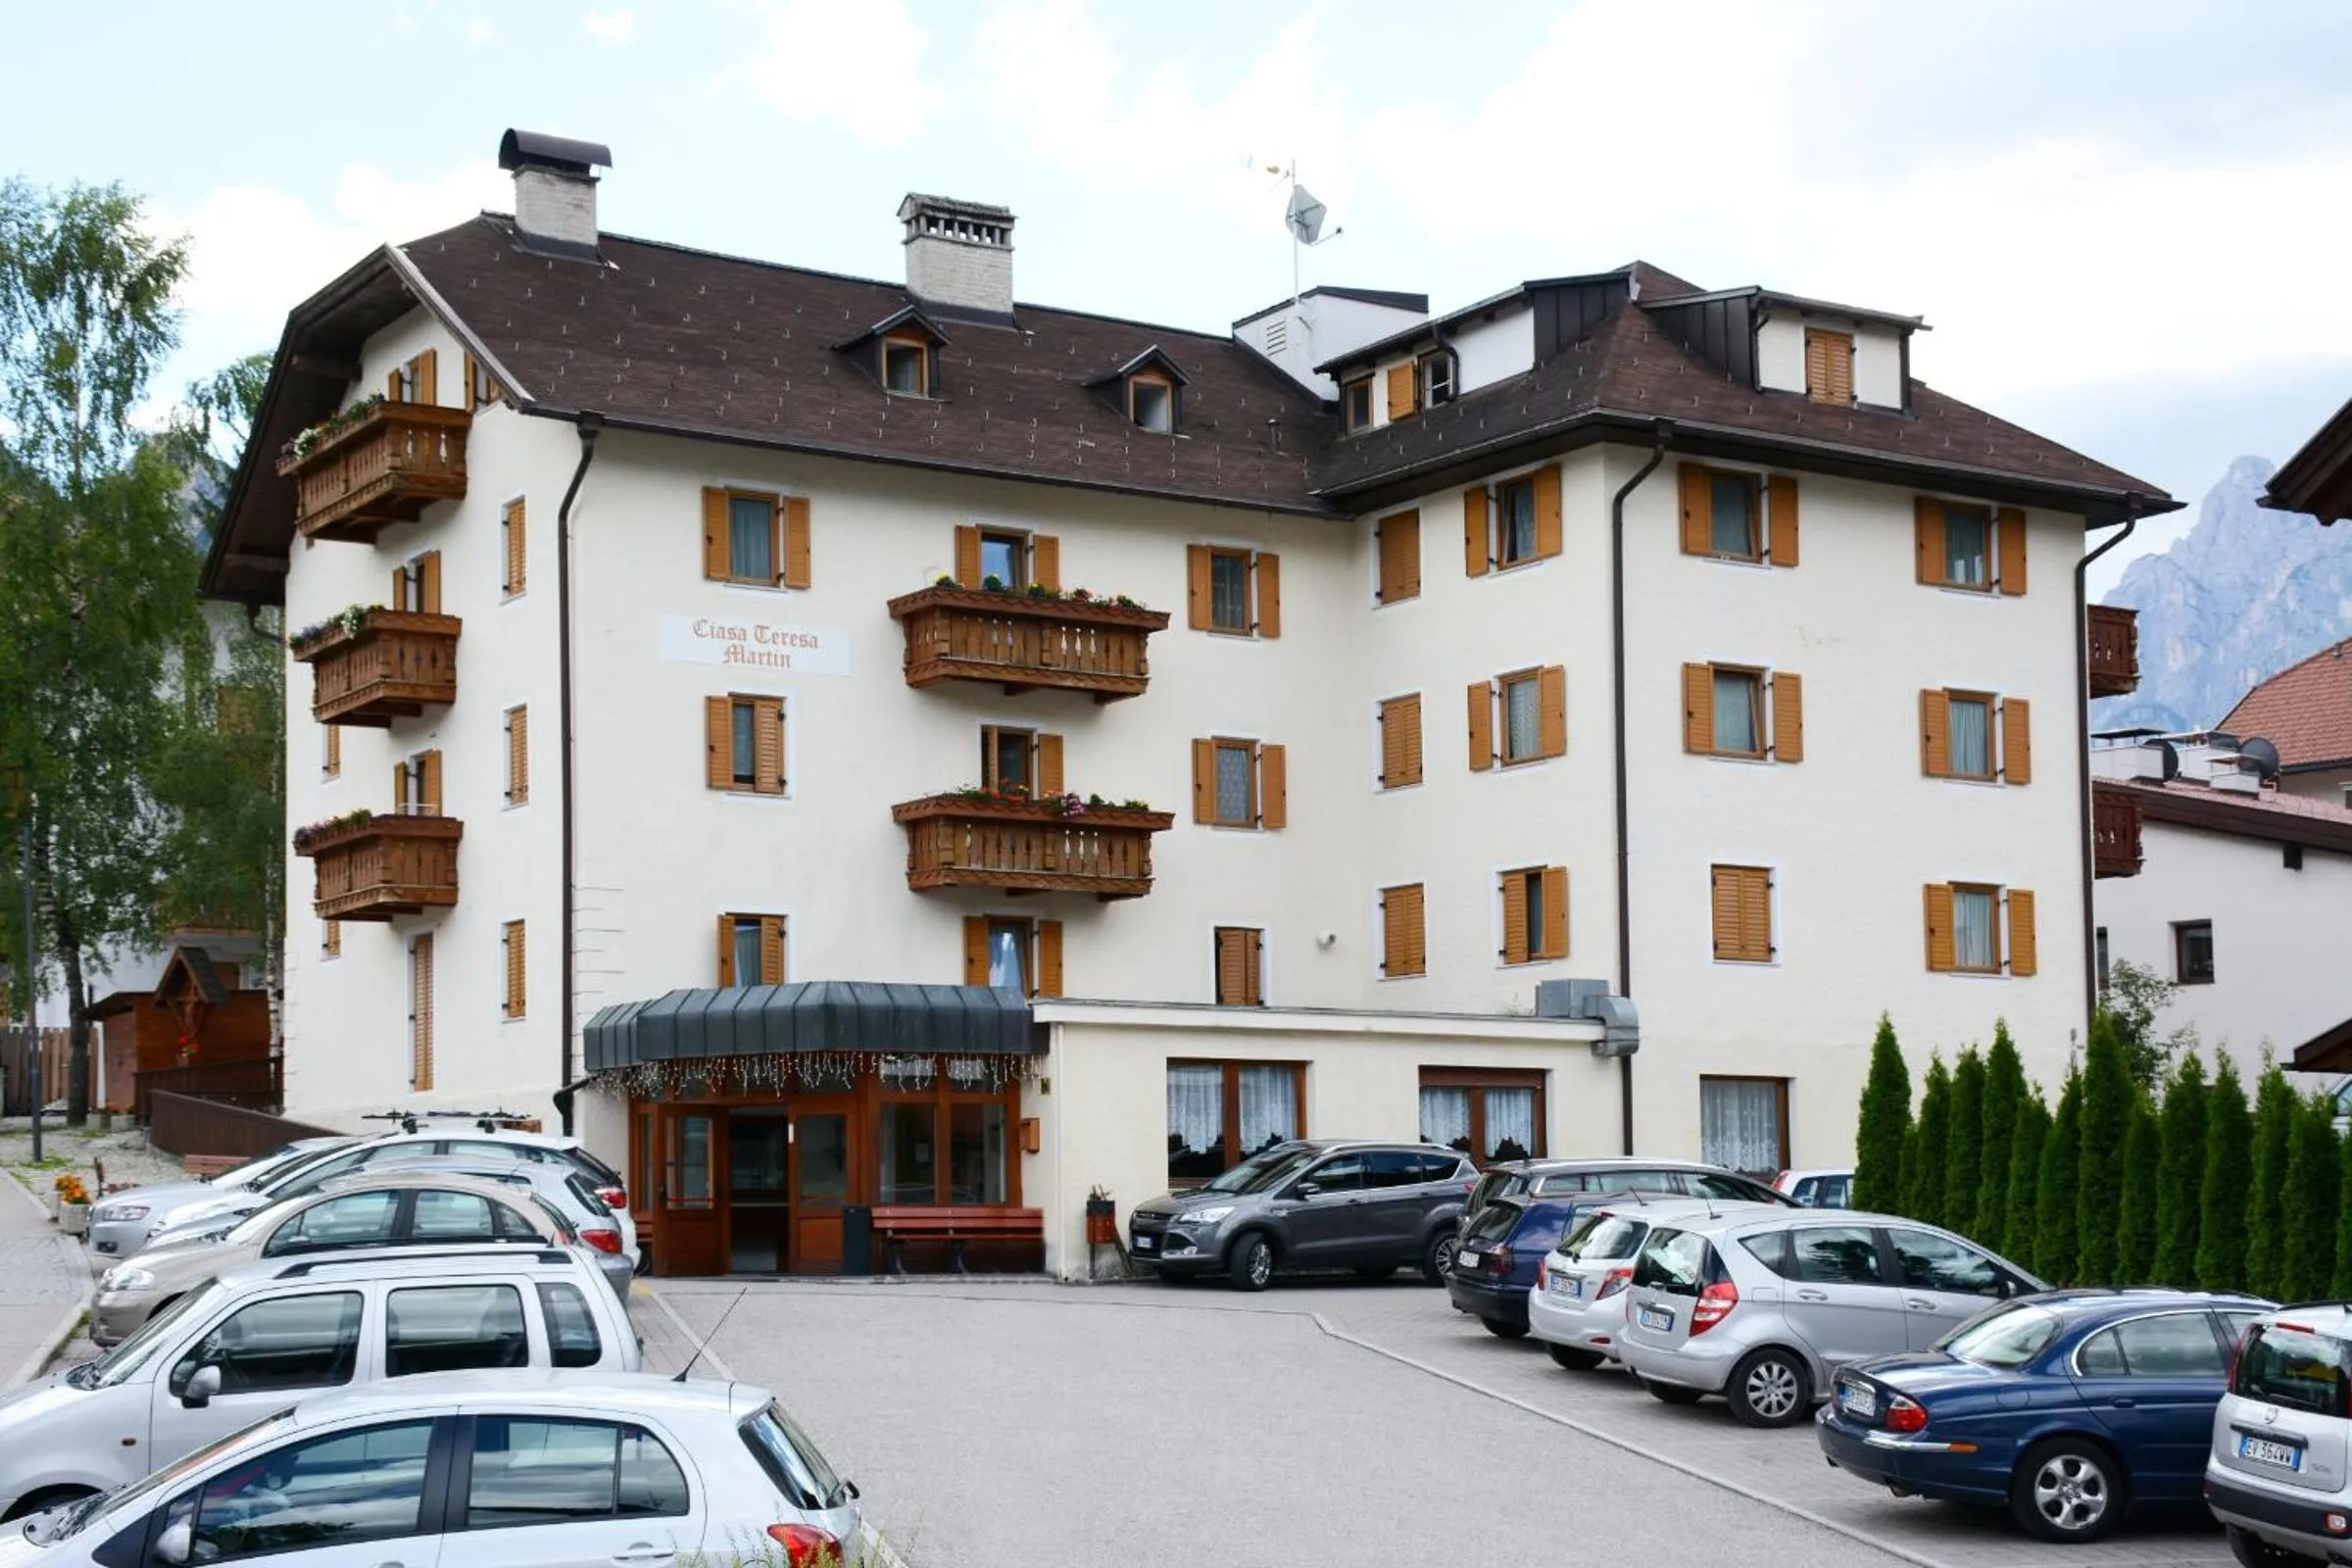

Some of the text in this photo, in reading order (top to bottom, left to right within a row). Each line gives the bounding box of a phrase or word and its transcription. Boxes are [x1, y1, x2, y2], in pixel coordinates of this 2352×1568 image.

[692, 618, 819, 649] Ciasa Teresa
[722, 643, 792, 668] Martin
